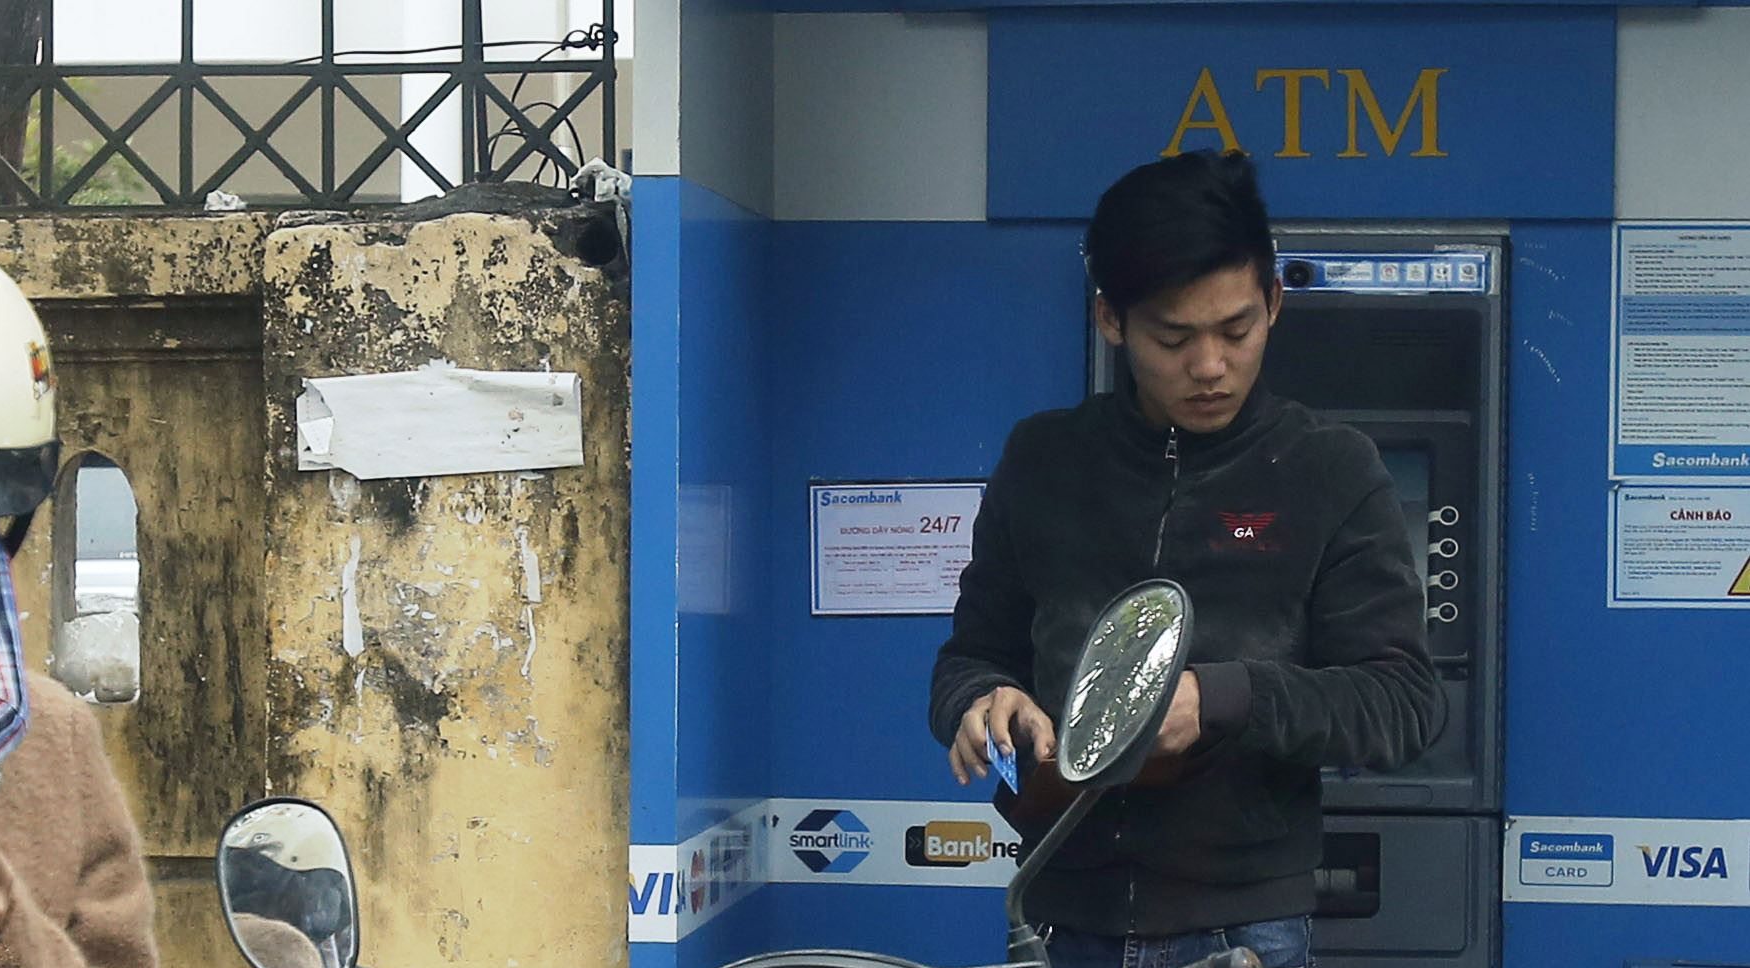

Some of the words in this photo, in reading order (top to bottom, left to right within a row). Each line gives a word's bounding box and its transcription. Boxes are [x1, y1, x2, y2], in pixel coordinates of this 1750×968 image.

[1159, 67, 1449, 157] ATM
[1652, 452, 1749, 468] Sacombank
[820, 490, 903, 507] Sacombank
[1670, 507, 1703, 520] CẢNH
[1706, 508, 1732, 520] BÁO
[919, 516, 962, 533] 24/7
[1234, 526, 1254, 538] GA
[789, 832, 872, 849] smartlink
[1529, 841, 1603, 854] Sacombank
[1635, 845, 1728, 879] VISA
[1545, 866, 1588, 878] CARD
